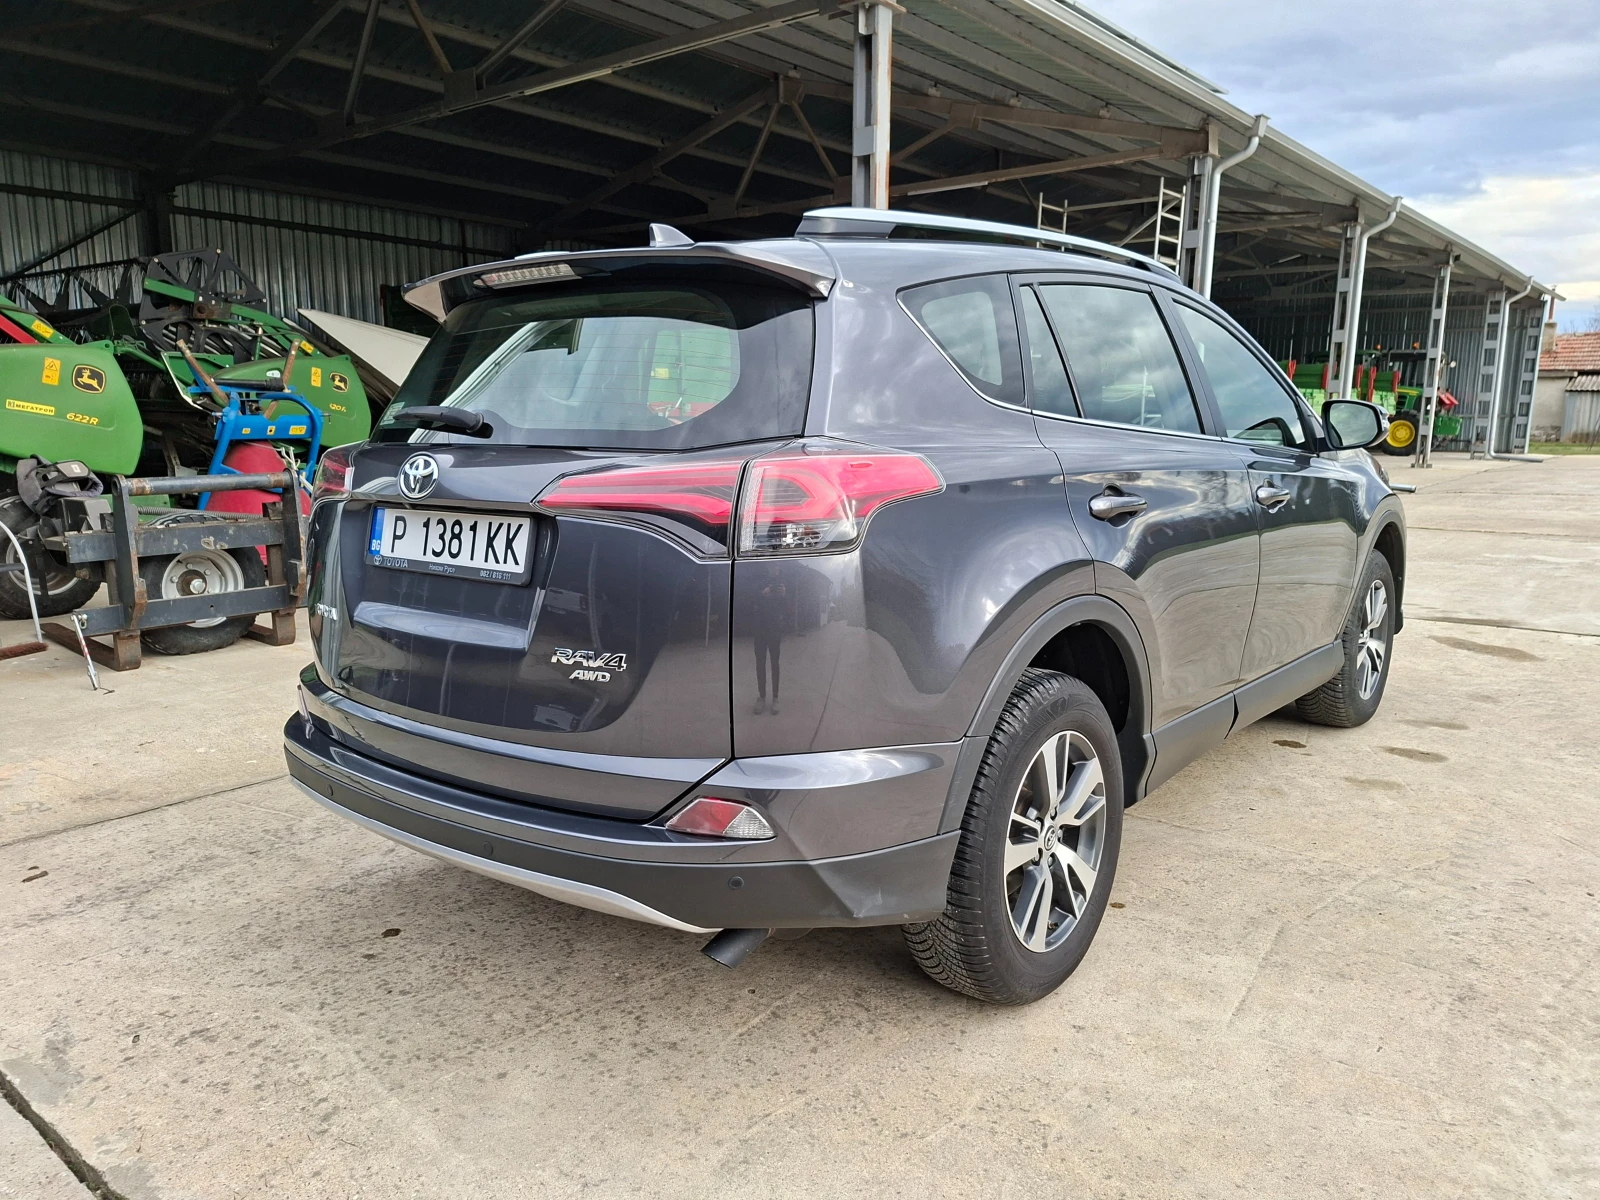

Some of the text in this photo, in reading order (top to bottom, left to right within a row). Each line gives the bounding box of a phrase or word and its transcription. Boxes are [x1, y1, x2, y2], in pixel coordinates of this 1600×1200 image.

[66, 412, 99, 426] 622R
[391, 515, 407, 553] P
[371, 539, 381, 551] BG
[383, 556, 408, 568] TOYOTA
[550, 647, 627, 672] RAV4
[568, 669, 611, 683] AWD
